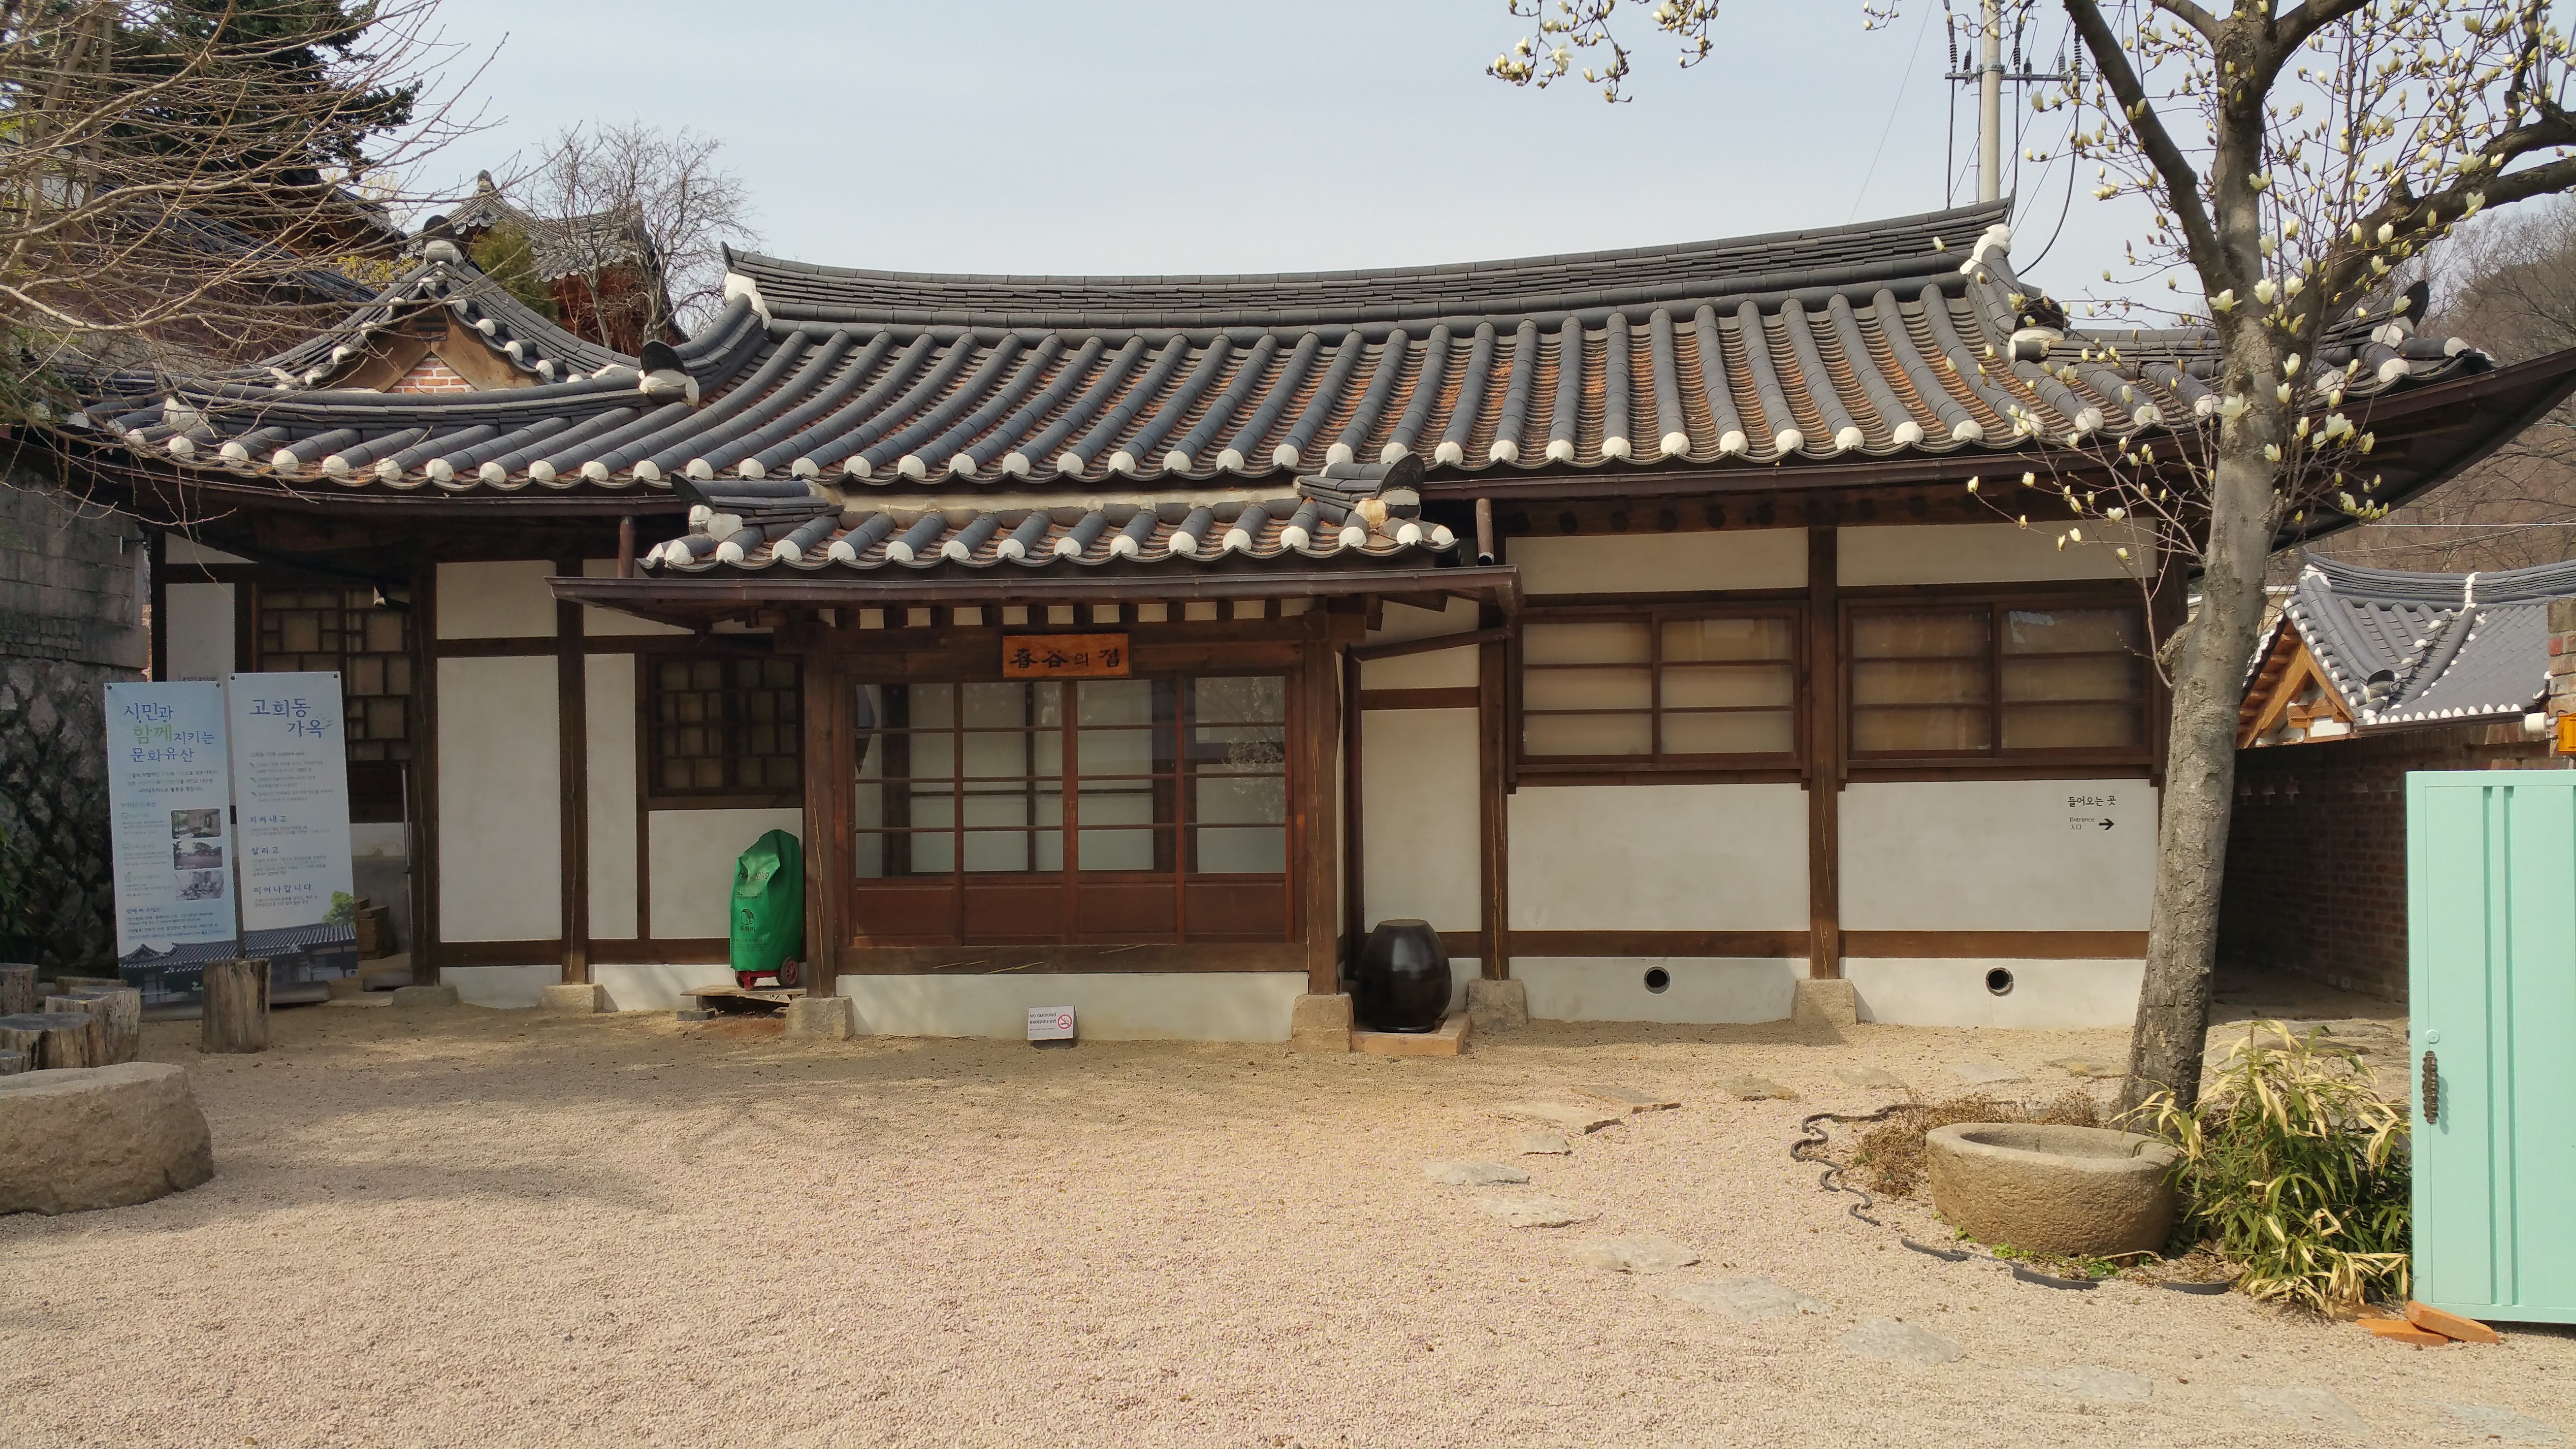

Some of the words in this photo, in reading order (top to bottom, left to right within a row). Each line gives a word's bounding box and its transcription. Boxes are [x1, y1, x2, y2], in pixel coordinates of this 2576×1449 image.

[1098, 648, 1120, 668] 집
[124, 703, 174, 723] 시민과
[249, 698, 311, 718] 고희동
[133, 724, 172, 744] 함께
[174, 731, 214, 744] 지키는
[287, 719, 325, 739] 가옥
[130, 747, 194, 763] 문화유산
[2068, 796, 2104, 807] 들어오는
[2107, 796, 2116, 805] 곳
[251, 846, 279, 855] 살리고
[254, 884, 311, 894] 이어나갑니다
